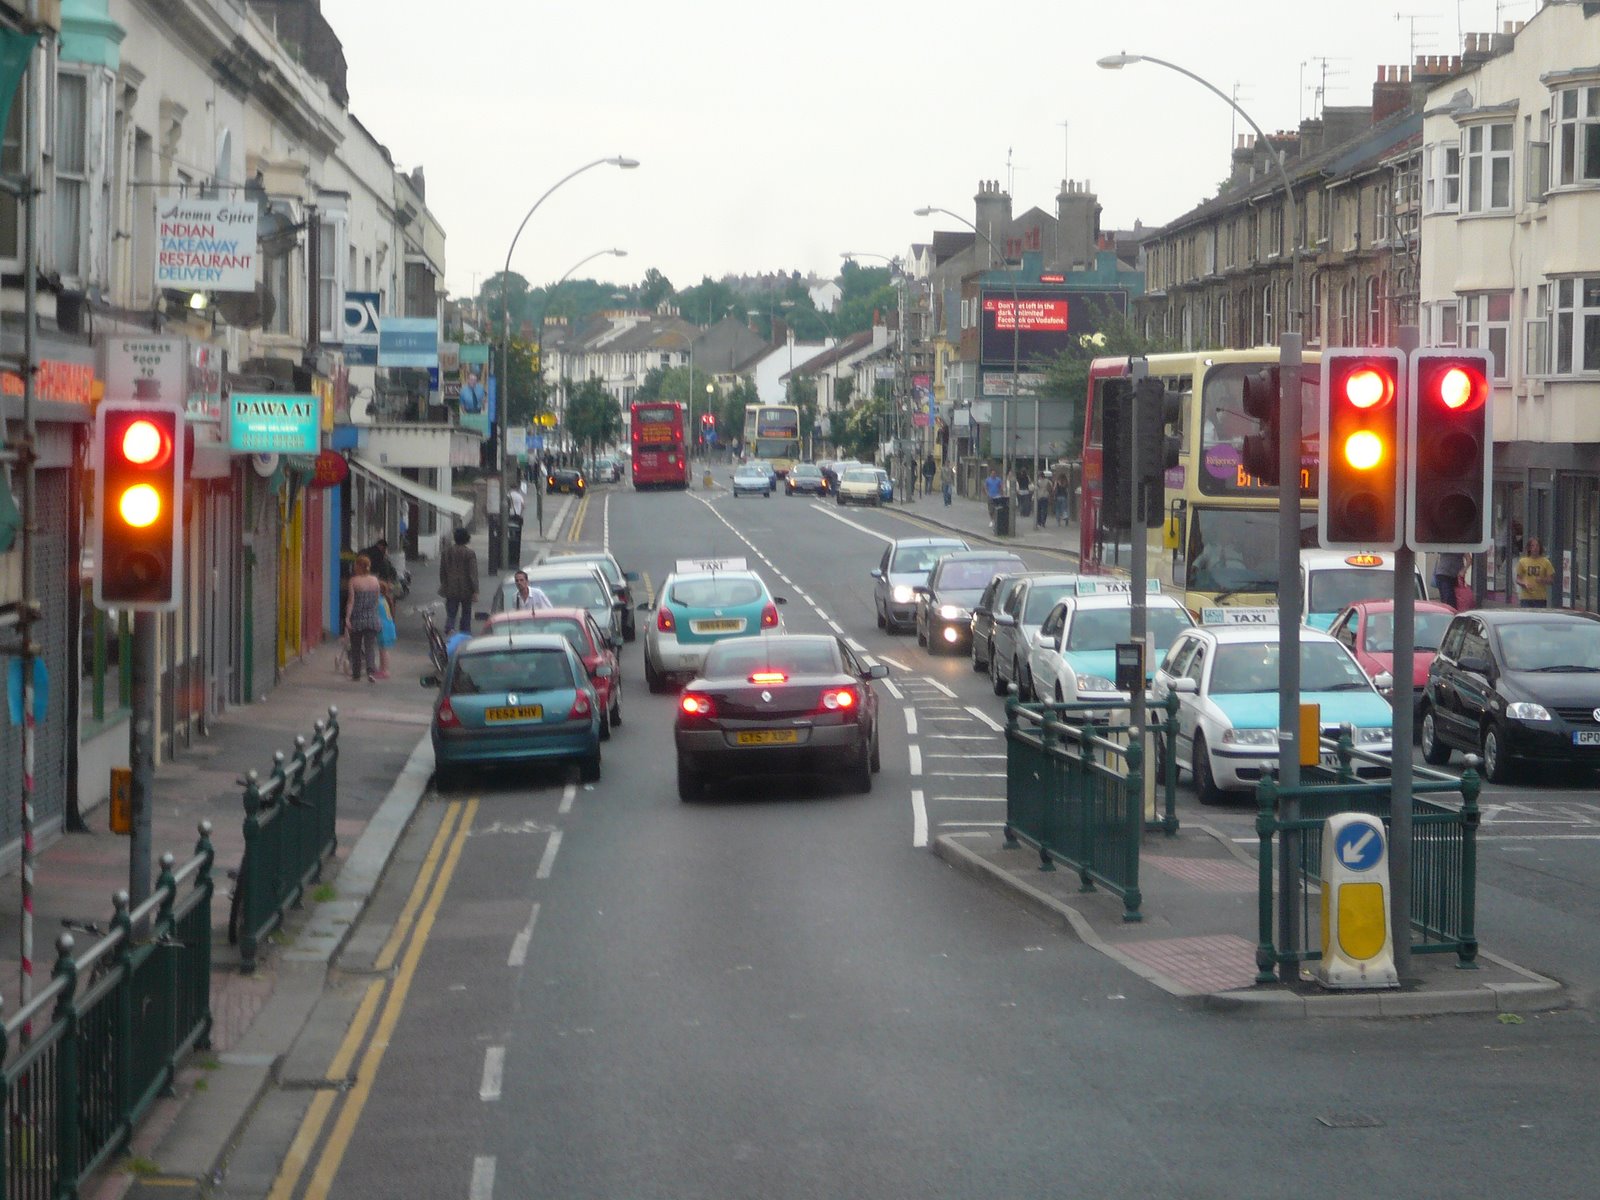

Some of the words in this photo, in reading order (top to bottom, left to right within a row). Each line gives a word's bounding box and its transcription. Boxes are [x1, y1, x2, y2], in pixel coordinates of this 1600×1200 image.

[160, 223, 215, 238] INDIAN
[161, 237, 238, 255] TAKEAWAY
[159, 252, 251, 268] RESTAURANT
[158, 266, 223, 282] DELIVERY
[132, 356, 161, 365] FOOD
[237, 401, 313, 418] DAWAAT
[700, 563, 723, 571] TAXI
[1232, 614, 1267, 623] TAXI
